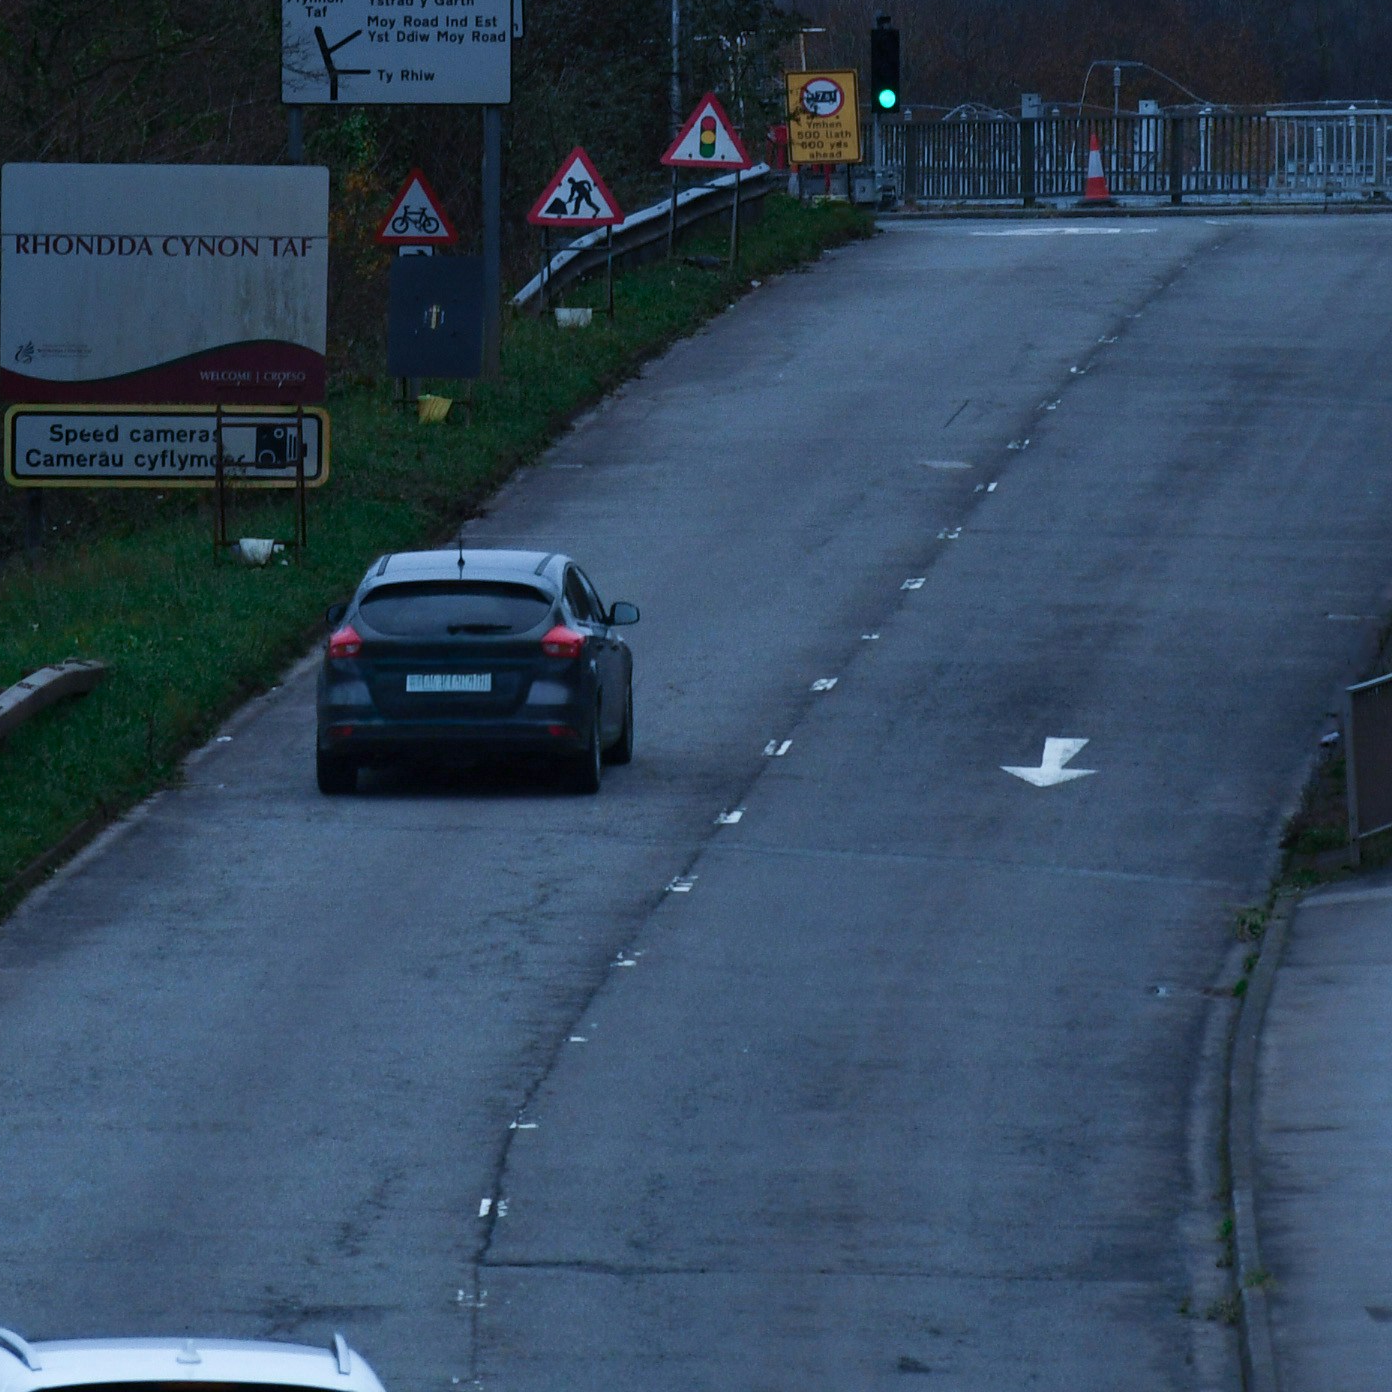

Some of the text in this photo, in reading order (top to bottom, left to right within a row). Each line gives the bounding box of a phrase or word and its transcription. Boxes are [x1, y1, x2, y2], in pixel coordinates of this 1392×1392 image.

[305, 6, 328, 18] Taf
[367, 16, 498, 29] Moy Road Ind Est
[368, 31, 506, 44] Yst Ddiw Moy Road
[377, 69, 435, 83] Ty Rhiw
[15, 234, 313, 257] RHONDDA CYNON TAF
[49, 423, 119, 445] Speed
[134, 449, 245, 470] cyflymr
